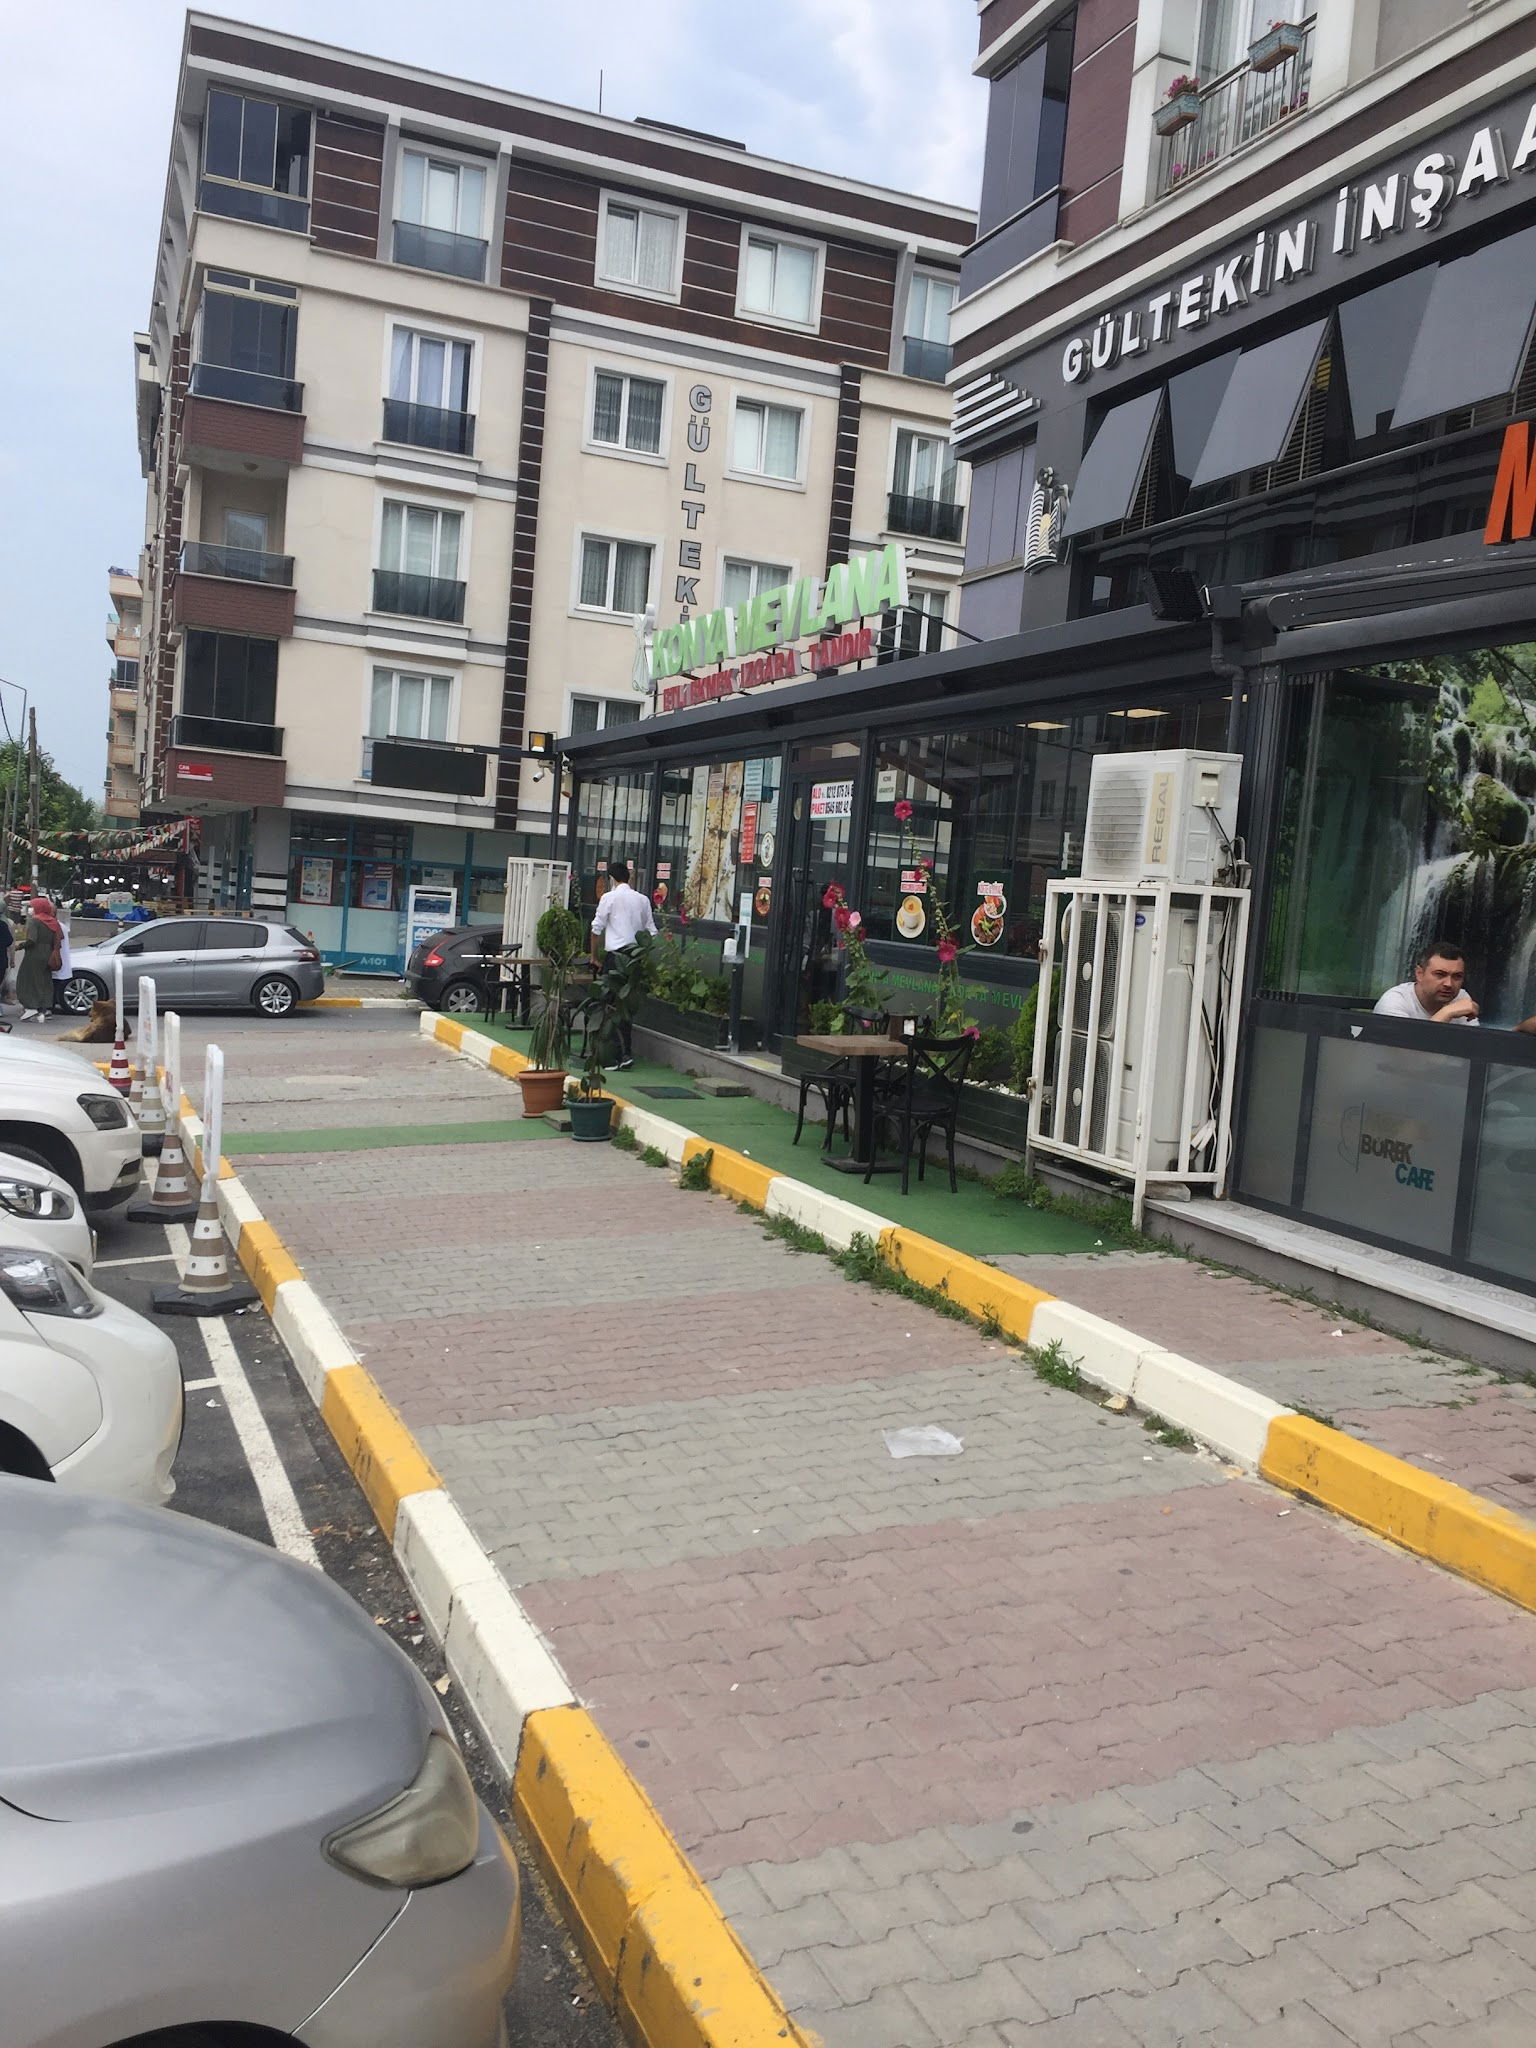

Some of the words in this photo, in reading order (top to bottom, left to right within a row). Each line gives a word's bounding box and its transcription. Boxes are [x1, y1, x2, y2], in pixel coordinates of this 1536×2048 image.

[1062, 219, 1309, 384] GÜLTEKİN
[651, 606, 737, 680] KONYA
[1151, 773, 1170, 863] REGAL
[1395, 1163, 1435, 1192] CAFE
